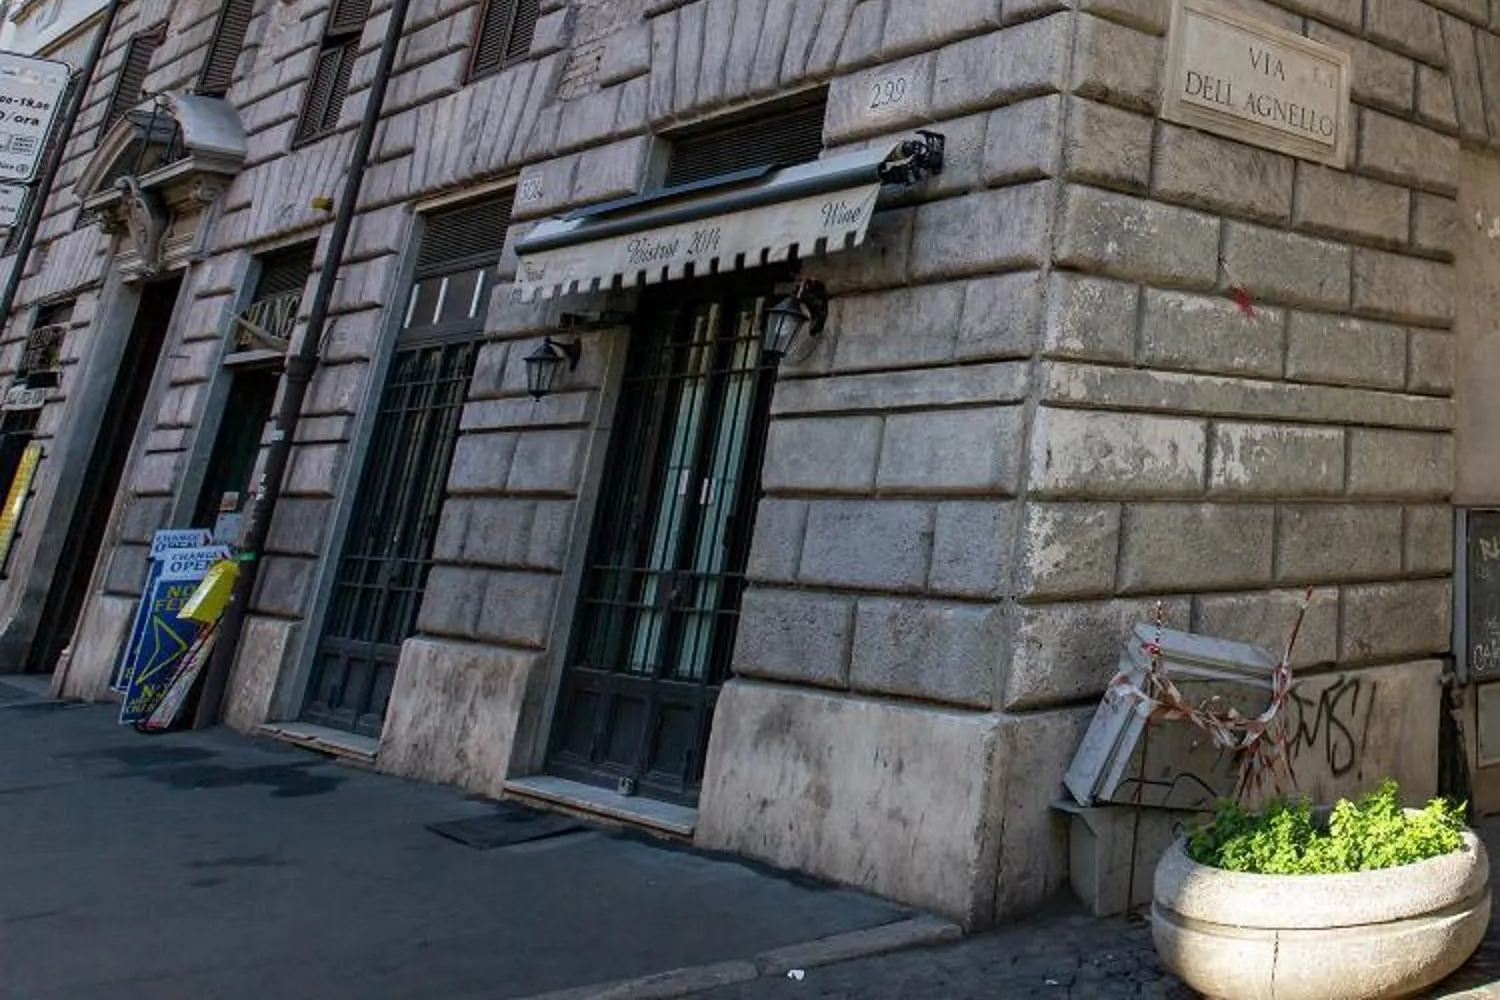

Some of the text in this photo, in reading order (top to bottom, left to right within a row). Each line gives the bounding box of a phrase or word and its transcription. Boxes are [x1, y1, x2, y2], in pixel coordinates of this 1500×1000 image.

[1249, 47, 1285, 81] VIA
[1244, 93, 1333, 137] AGNELLO
[821, 201, 861, 227] Wine
